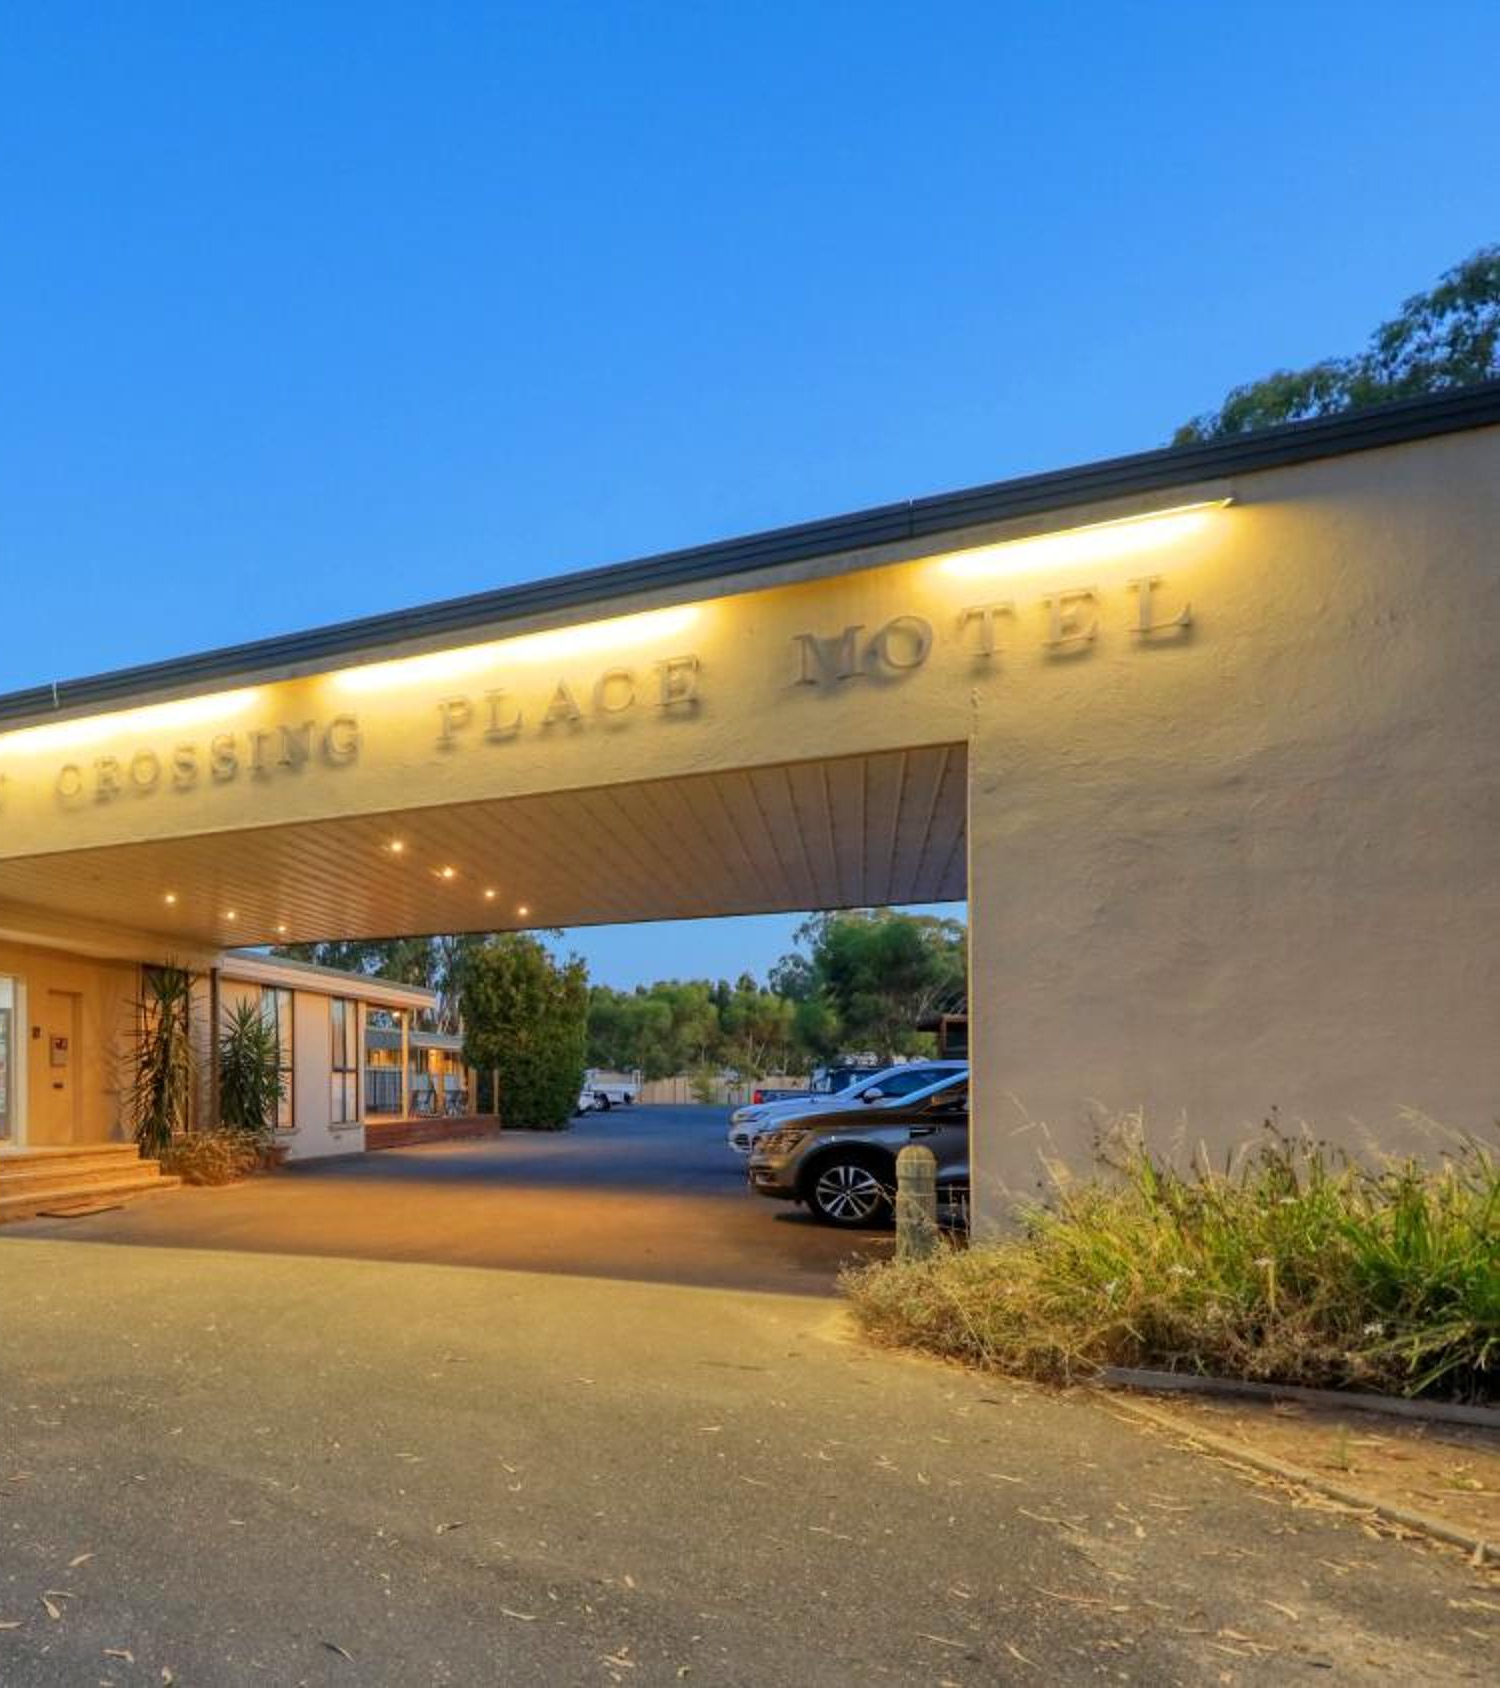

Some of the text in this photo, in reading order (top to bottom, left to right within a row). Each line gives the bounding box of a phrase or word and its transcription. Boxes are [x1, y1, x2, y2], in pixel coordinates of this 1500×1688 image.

[56, 714, 360, 799] CROSSING
[436, 654, 700, 742] PLACE
[792, 575, 1193, 686] MOTEL
